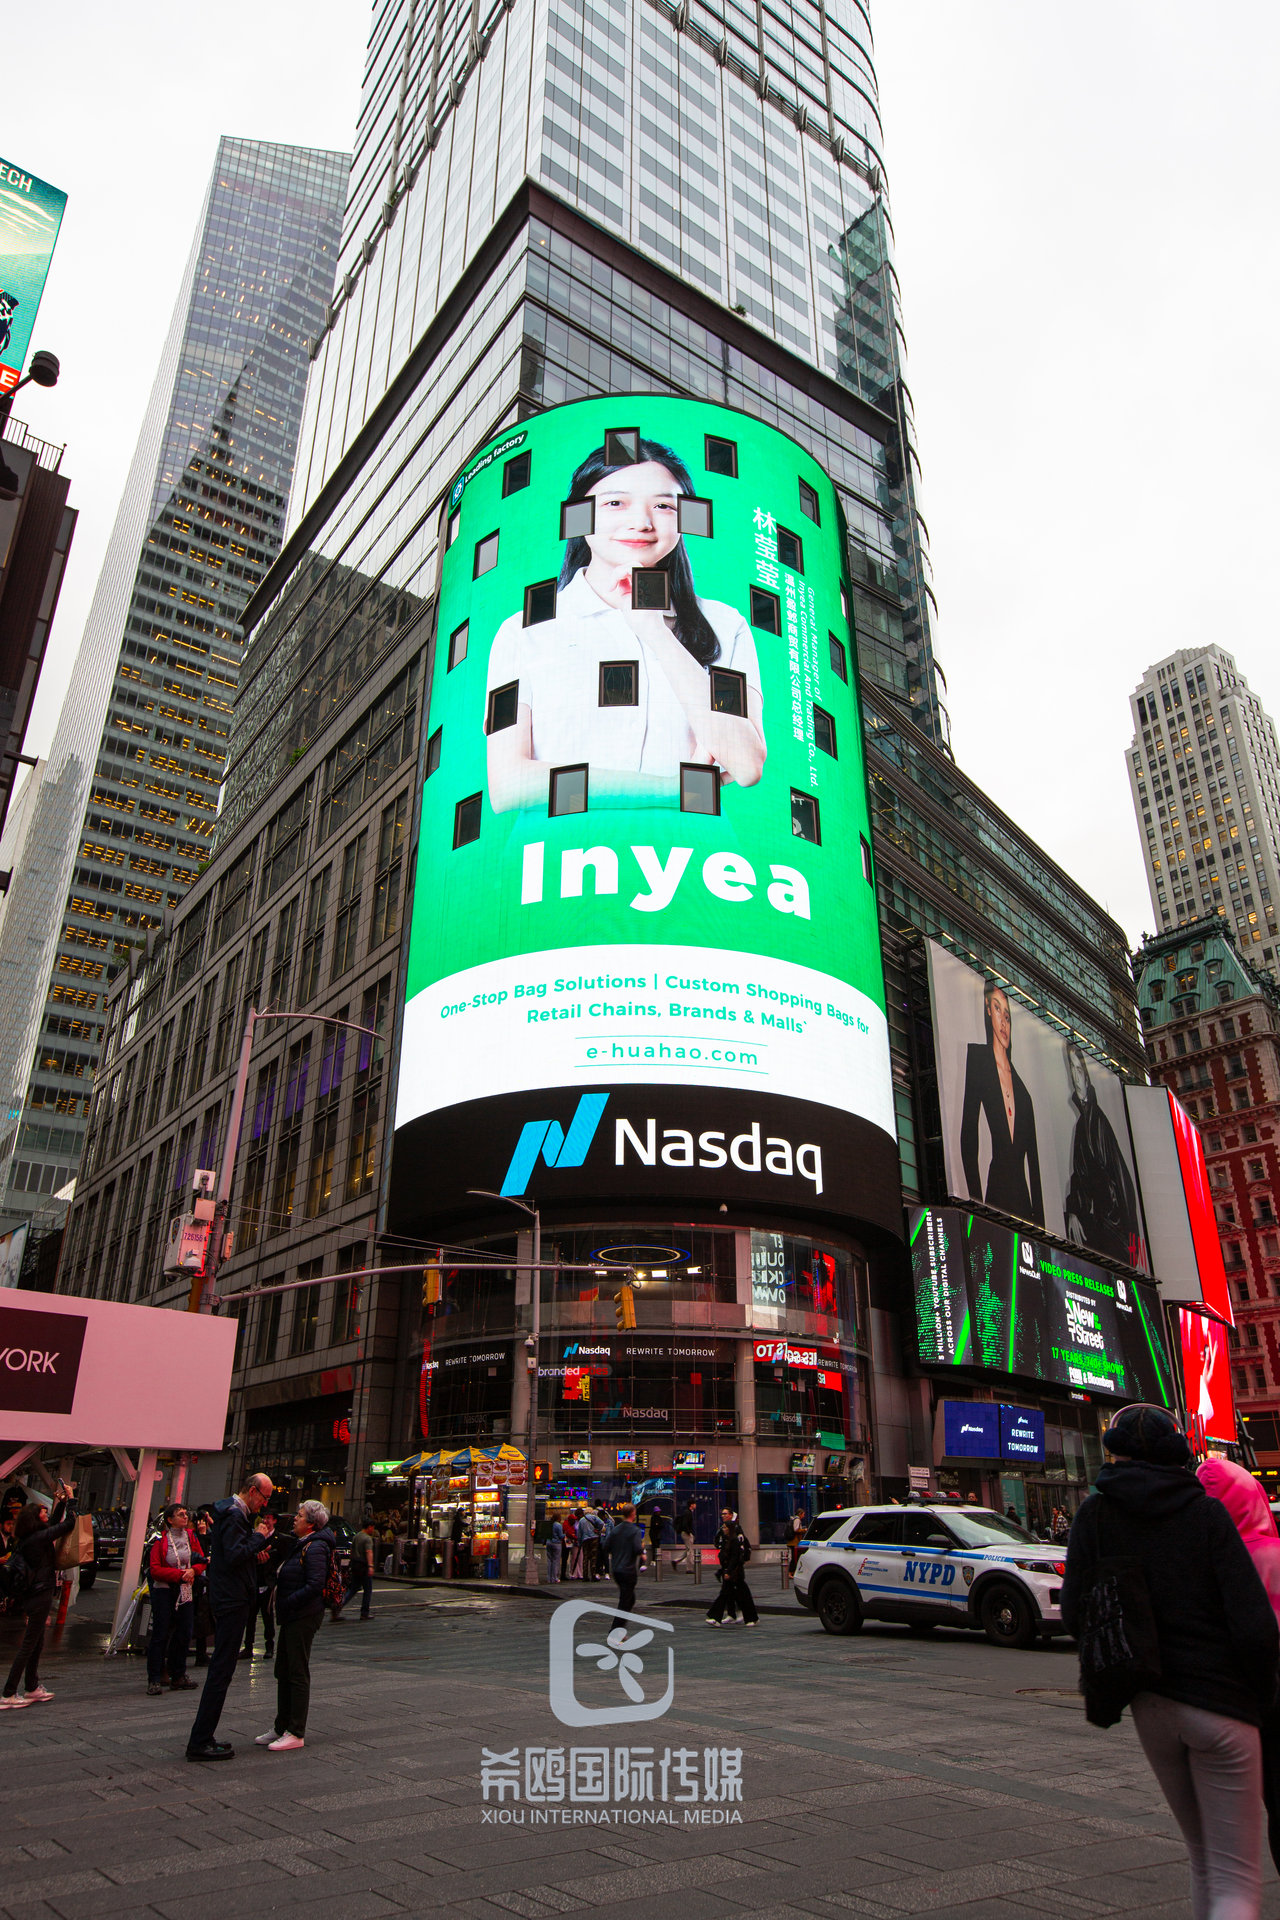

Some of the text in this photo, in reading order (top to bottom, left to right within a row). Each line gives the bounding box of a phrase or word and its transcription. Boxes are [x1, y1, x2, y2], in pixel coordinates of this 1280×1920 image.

[465, 434, 525, 483] Leading factory
[797, 580, 806, 609] Inyea
[800, 611, 812, 674] Commercial
[807, 587, 823, 702] General Manager of
[804, 673, 813, 698] And
[805, 699, 816, 741] Trading
[809, 766, 819, 787] Ltd.
[521, 841, 811, 920] Inyea
[440, 990, 508, 1019] One-Stop
[514, 983, 547, 998] Bag
[554, 974, 647, 992] Solutions
[665, 975, 740, 994] Custom
[746, 983, 822, 1016] Shopping
[827, 1003, 854, 1026] Bags
[856, 1017, 869, 1035] for
[527, 1003, 581, 1023] Retail
[588, 1001, 661, 1018] Chains,
[669, 1003, 737, 1021] Brands
[743, 1010, 755, 1024] &
[586, 1043, 758, 1065] e-huahao.com
[615, 1118, 824, 1195] Nasdaq
[926, 1211, 937, 1267] SUBSCRIBERS
[930, 1269, 940, 1309] YOUTUBE
[936, 1217, 955, 1355] ACROSS OUR DIGITAL CHANNELS
[1039, 1260, 1115, 1298] VIDEO PRESS RELEASES
[1072, 1300, 1094, 1328] New
[935, 1311, 944, 1353] MILLION+
[1075, 1324, 1105, 1350] Street
[445, 1356, 467, 1367] REWRITE
[469, 1353, 506, 1363] TOMORROW
[578, 1346, 611, 1356] Nasdaq
[626, 1347, 664, 1355] REWRITE
[1051, 1346, 1059, 1359] 17
[538, 1366, 579, 1376] branded
[622, 1407, 668, 1421] Nasdaq
[1007, 1442, 1039, 1453] TOMORROW
[1011, 1429, 1035, 1439] REWRITE
[983, 1554, 1006, 1562] POLICE
[903, 1561, 956, 1586] NYPD
